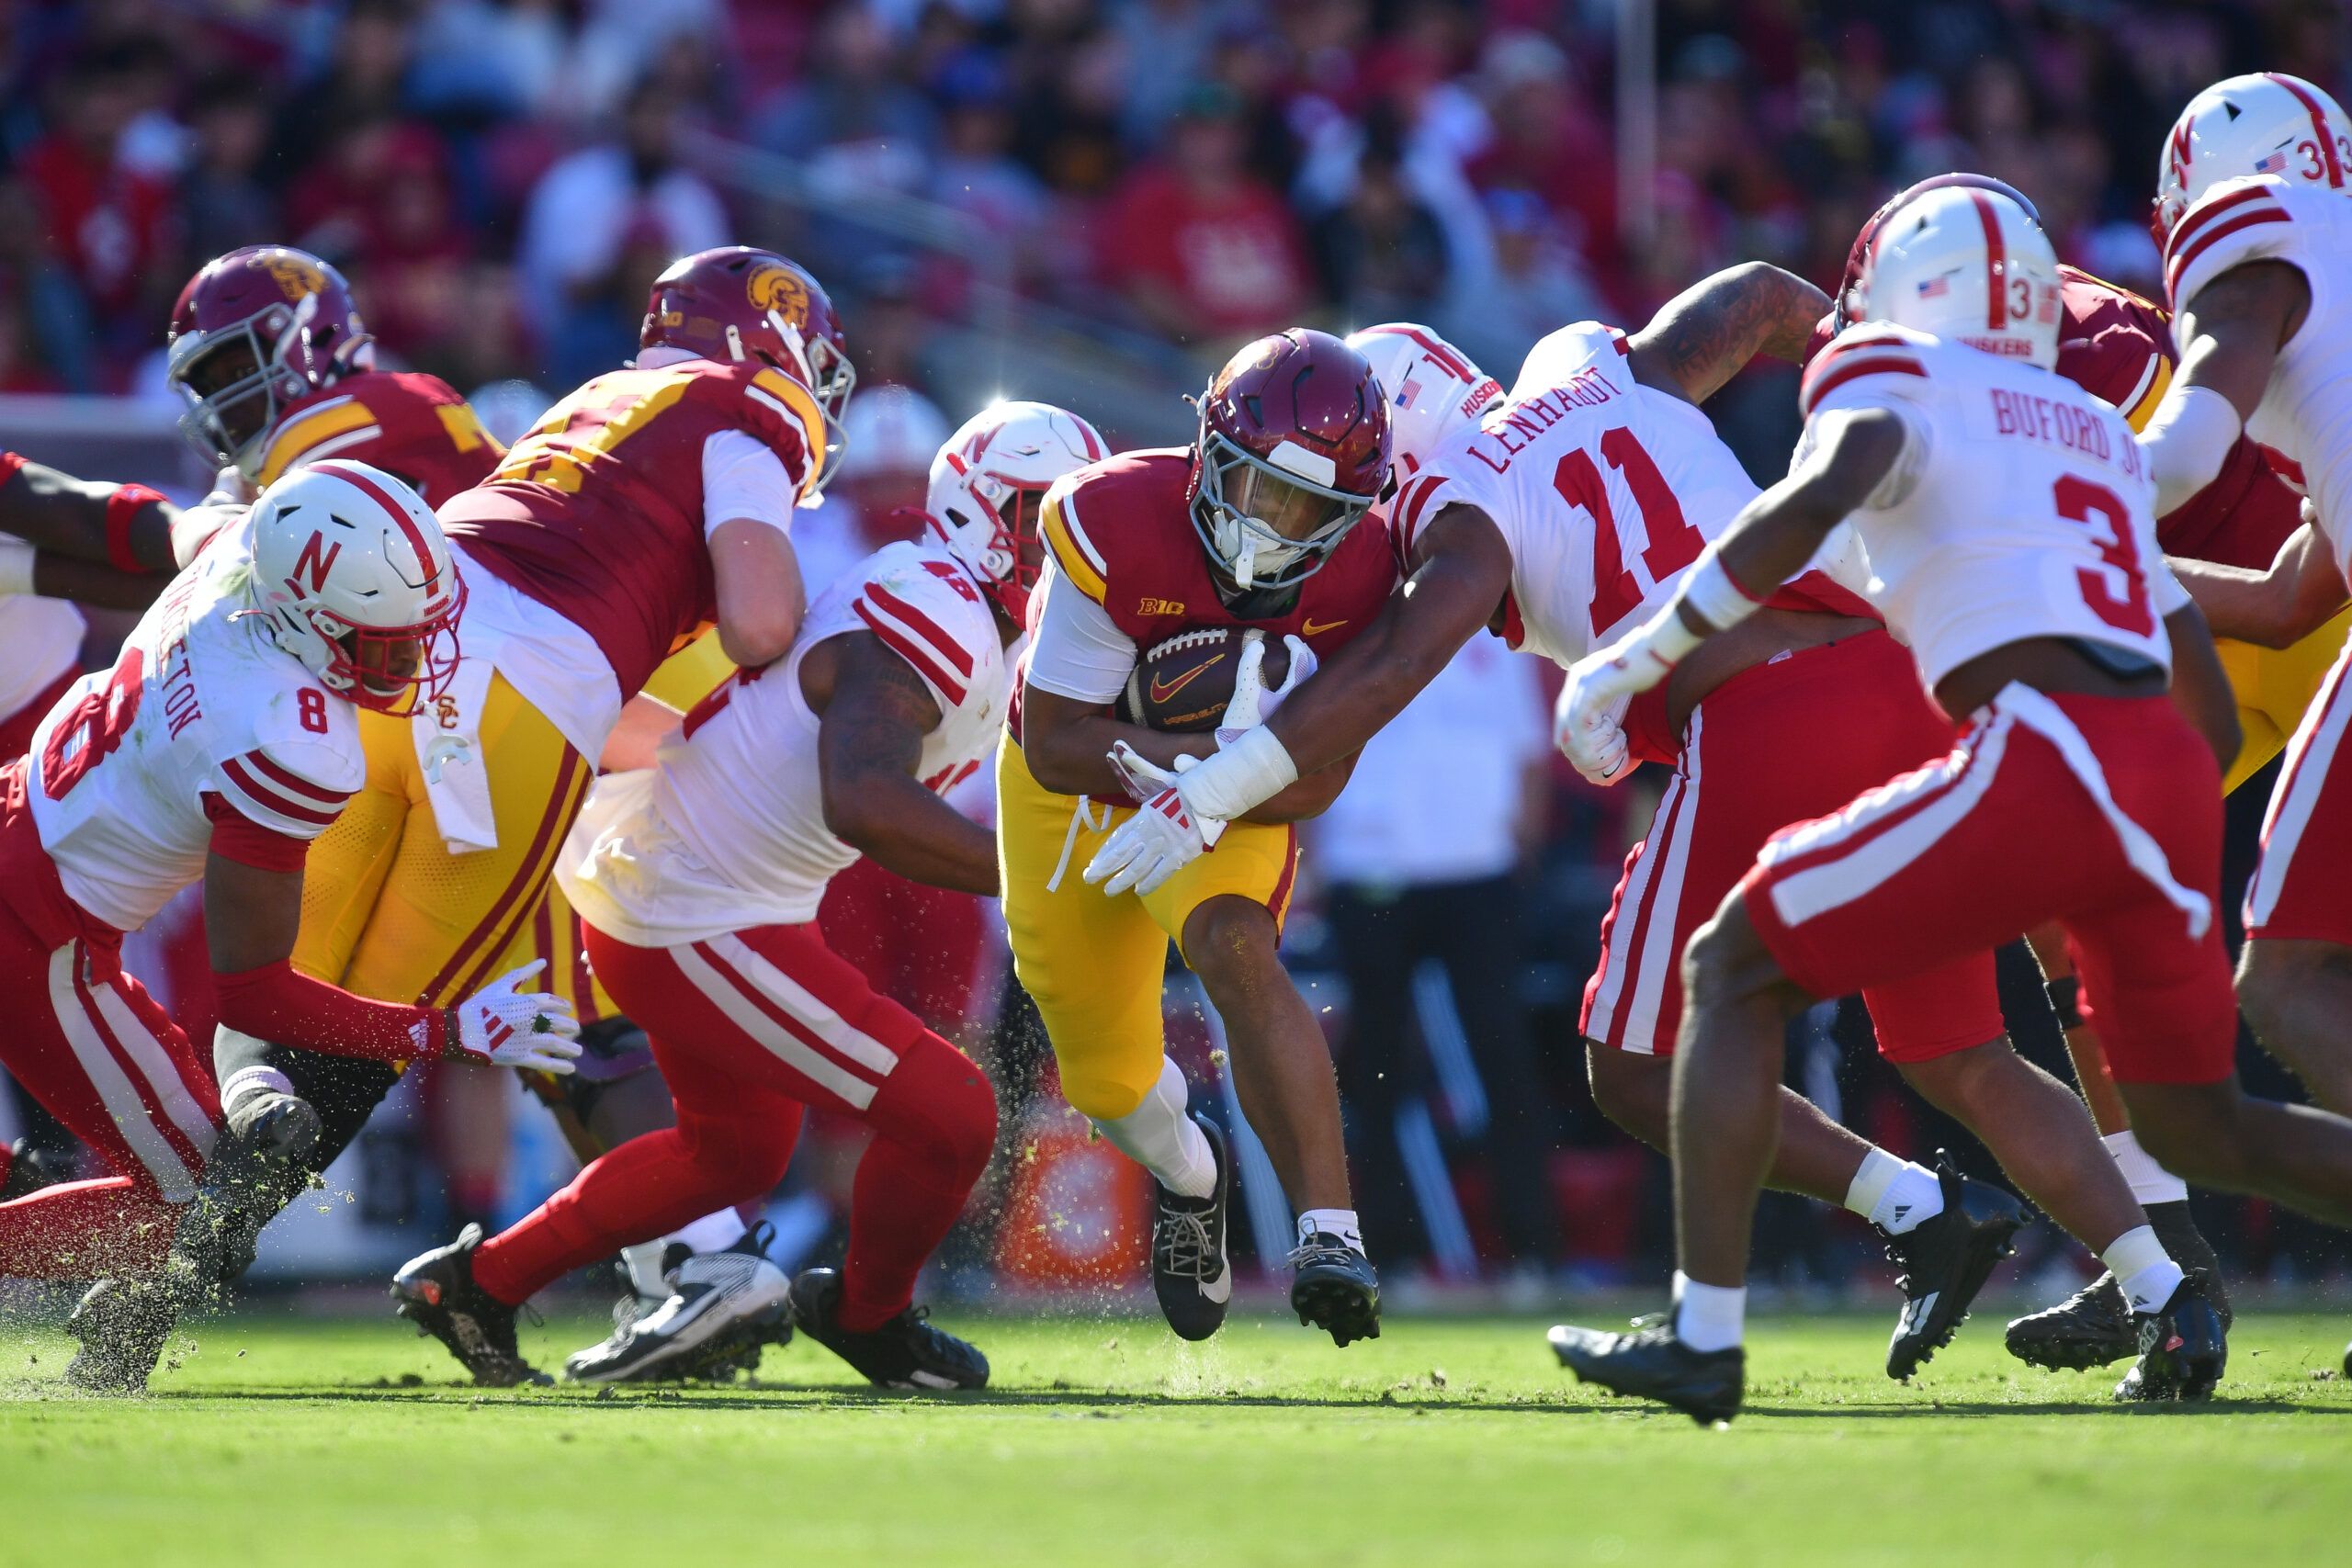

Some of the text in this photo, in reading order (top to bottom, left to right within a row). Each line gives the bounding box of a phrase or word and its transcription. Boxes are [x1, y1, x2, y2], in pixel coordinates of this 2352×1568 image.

[2171, 114, 2196, 175] N
[2009, 277, 2031, 321] 3
[1466, 367, 1622, 474] LENHARDT
[1990, 388, 2110, 461] BUFORD
[292, 529, 342, 593] N
[1554, 426, 1709, 638] 11
[2052, 472, 2154, 639] 3
[43, 647, 143, 801] 8
[297, 687, 328, 734] 8
